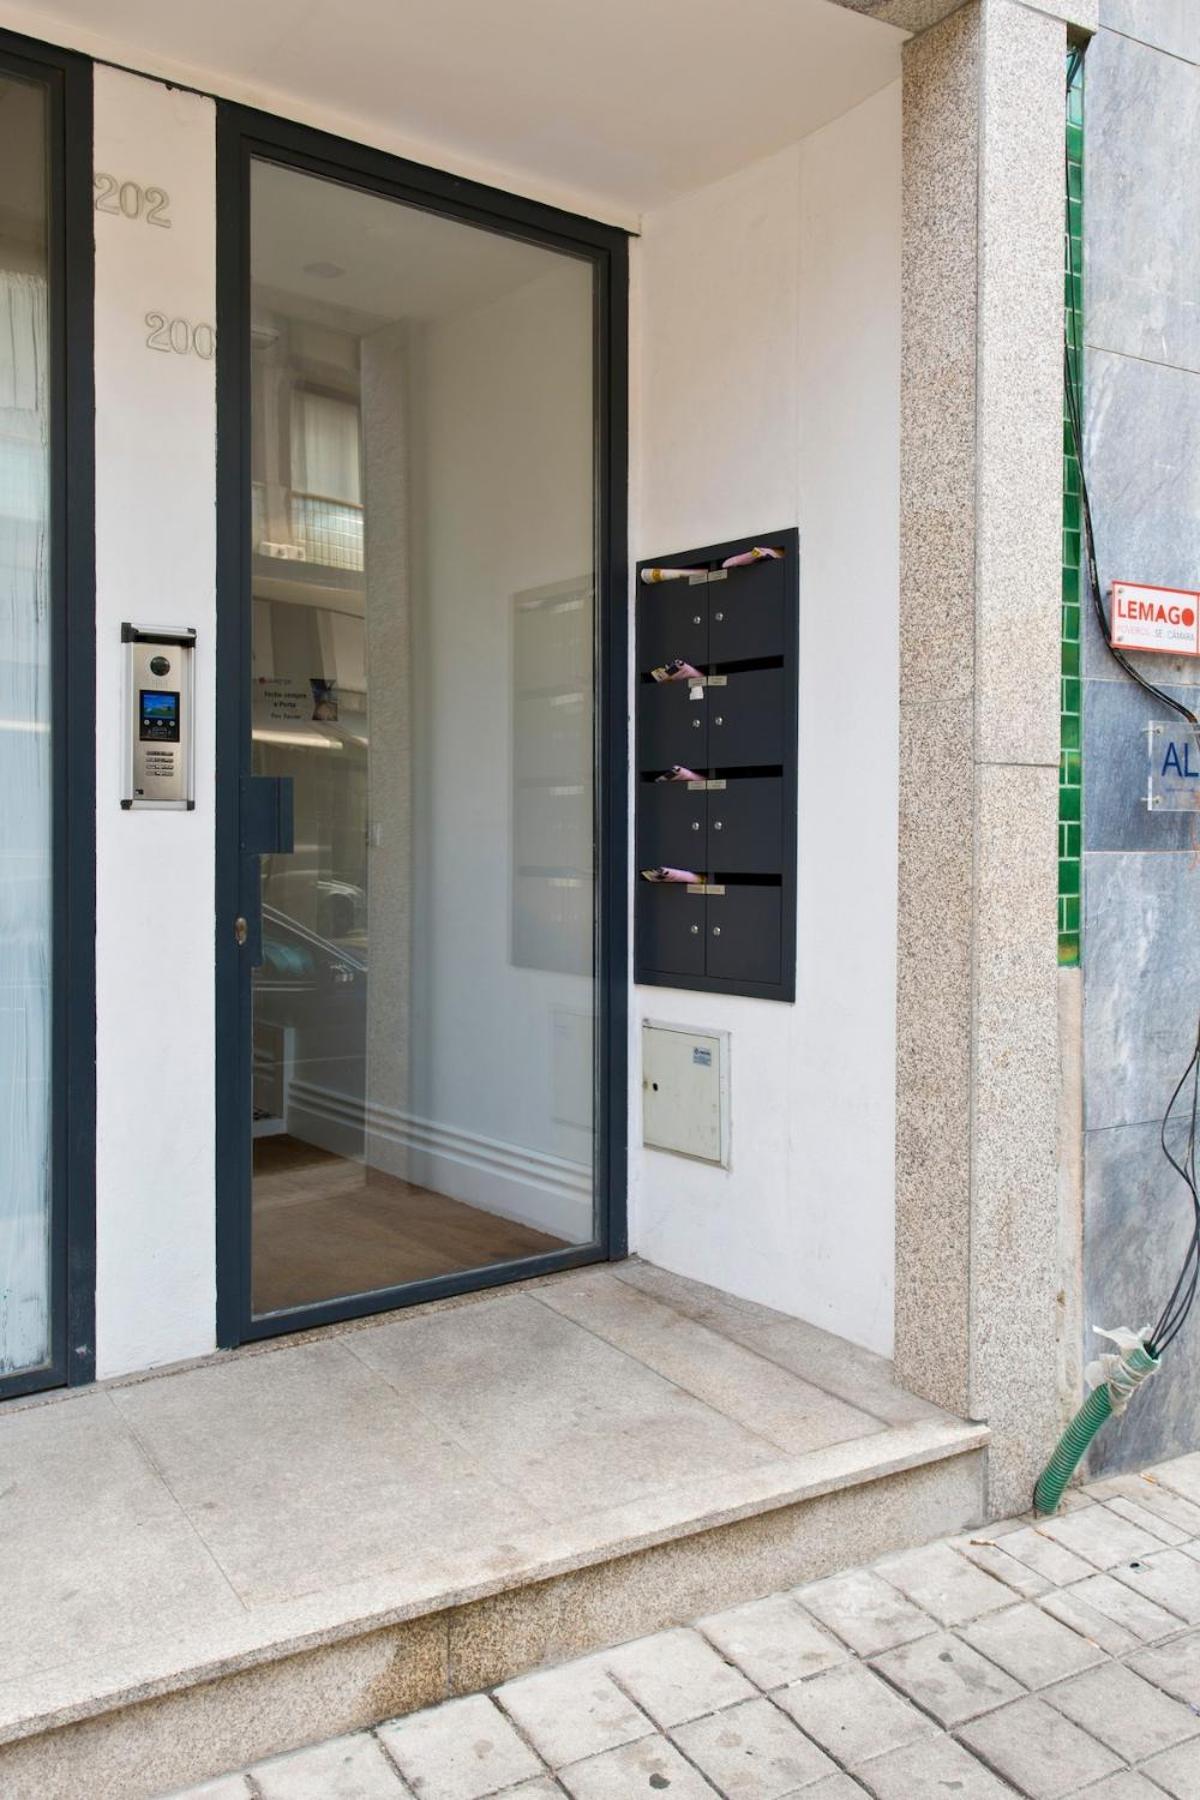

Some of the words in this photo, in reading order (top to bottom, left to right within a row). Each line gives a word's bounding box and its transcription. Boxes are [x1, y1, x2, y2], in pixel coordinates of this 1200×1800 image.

[93, 173, 172, 229] 202
[145, 311, 216, 360] 200
[1117, 598, 1195, 627] LEMAGO
[1161, 742, 1199, 777] AL
